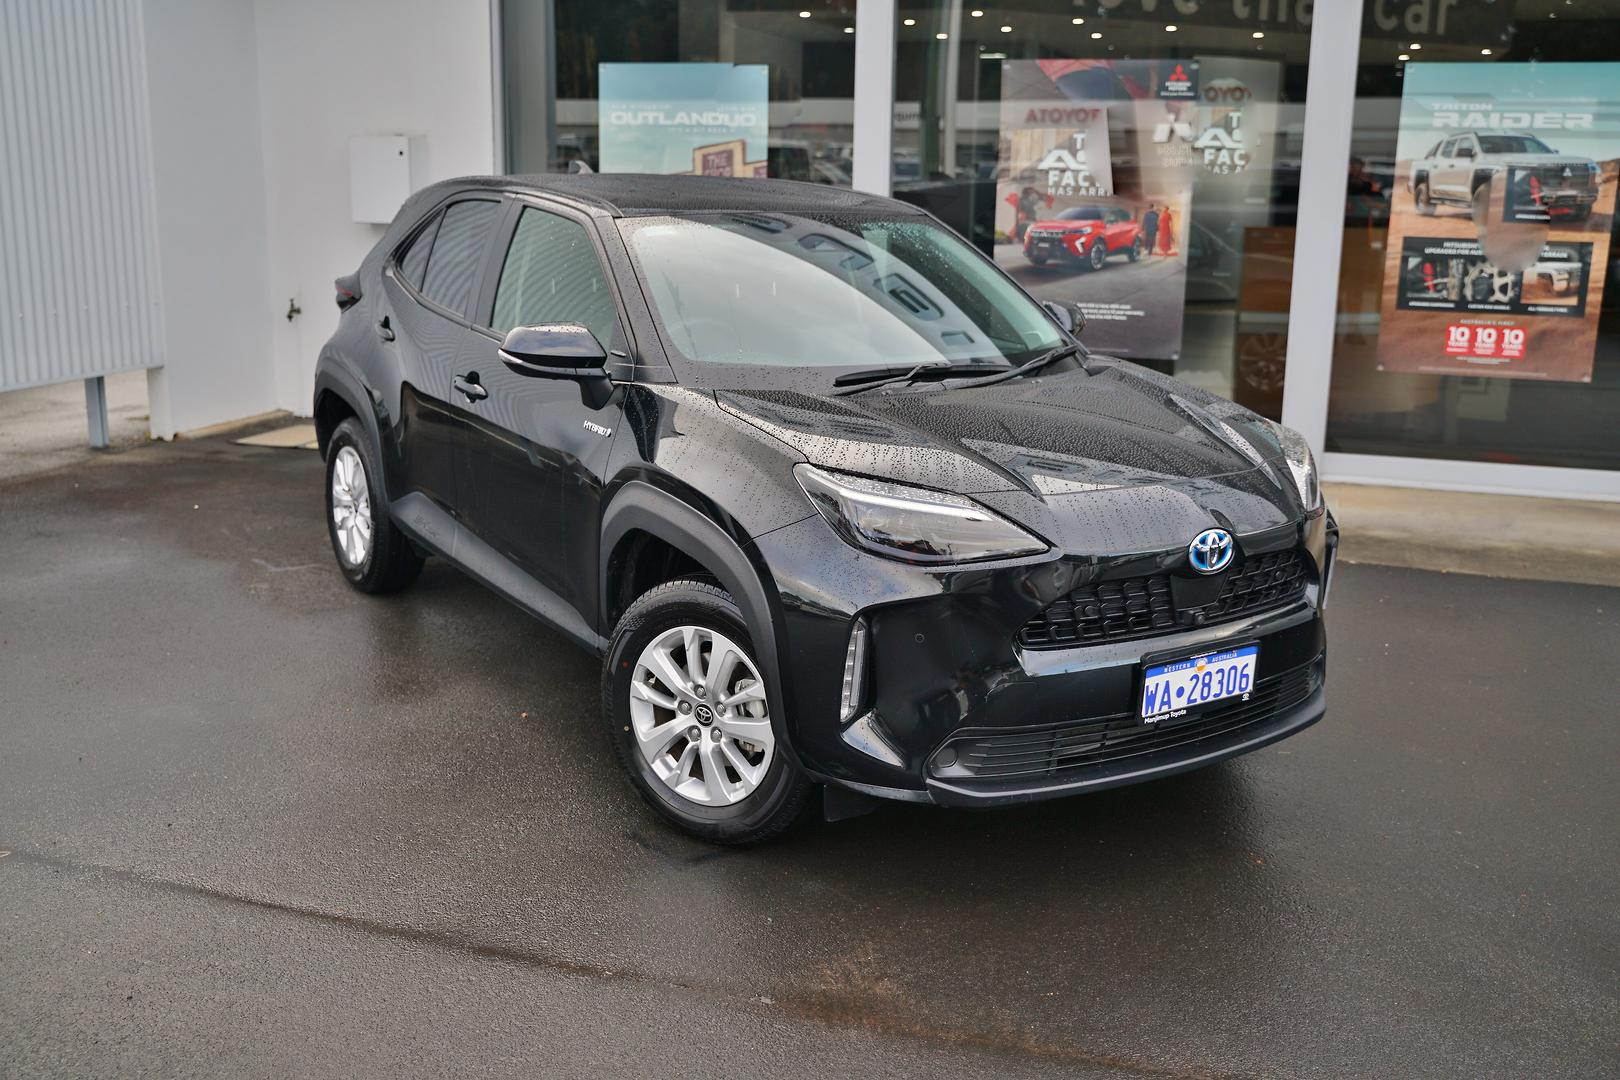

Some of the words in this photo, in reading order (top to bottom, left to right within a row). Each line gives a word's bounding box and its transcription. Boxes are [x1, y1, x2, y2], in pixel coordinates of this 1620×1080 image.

[1432, 112, 1593, 129] RAIDER
[706, 153, 728, 168] THE
[1047, 186, 1073, 197] HAS
[1449, 326, 1470, 343] 10
[1476, 327, 1497, 345] 10
[1503, 329, 1524, 346] 10
[1164, 662, 1191, 673] WESTERN
[1211, 651, 1238, 663] AUSTRALIA
[1170, 708, 1187, 719] Toyota
